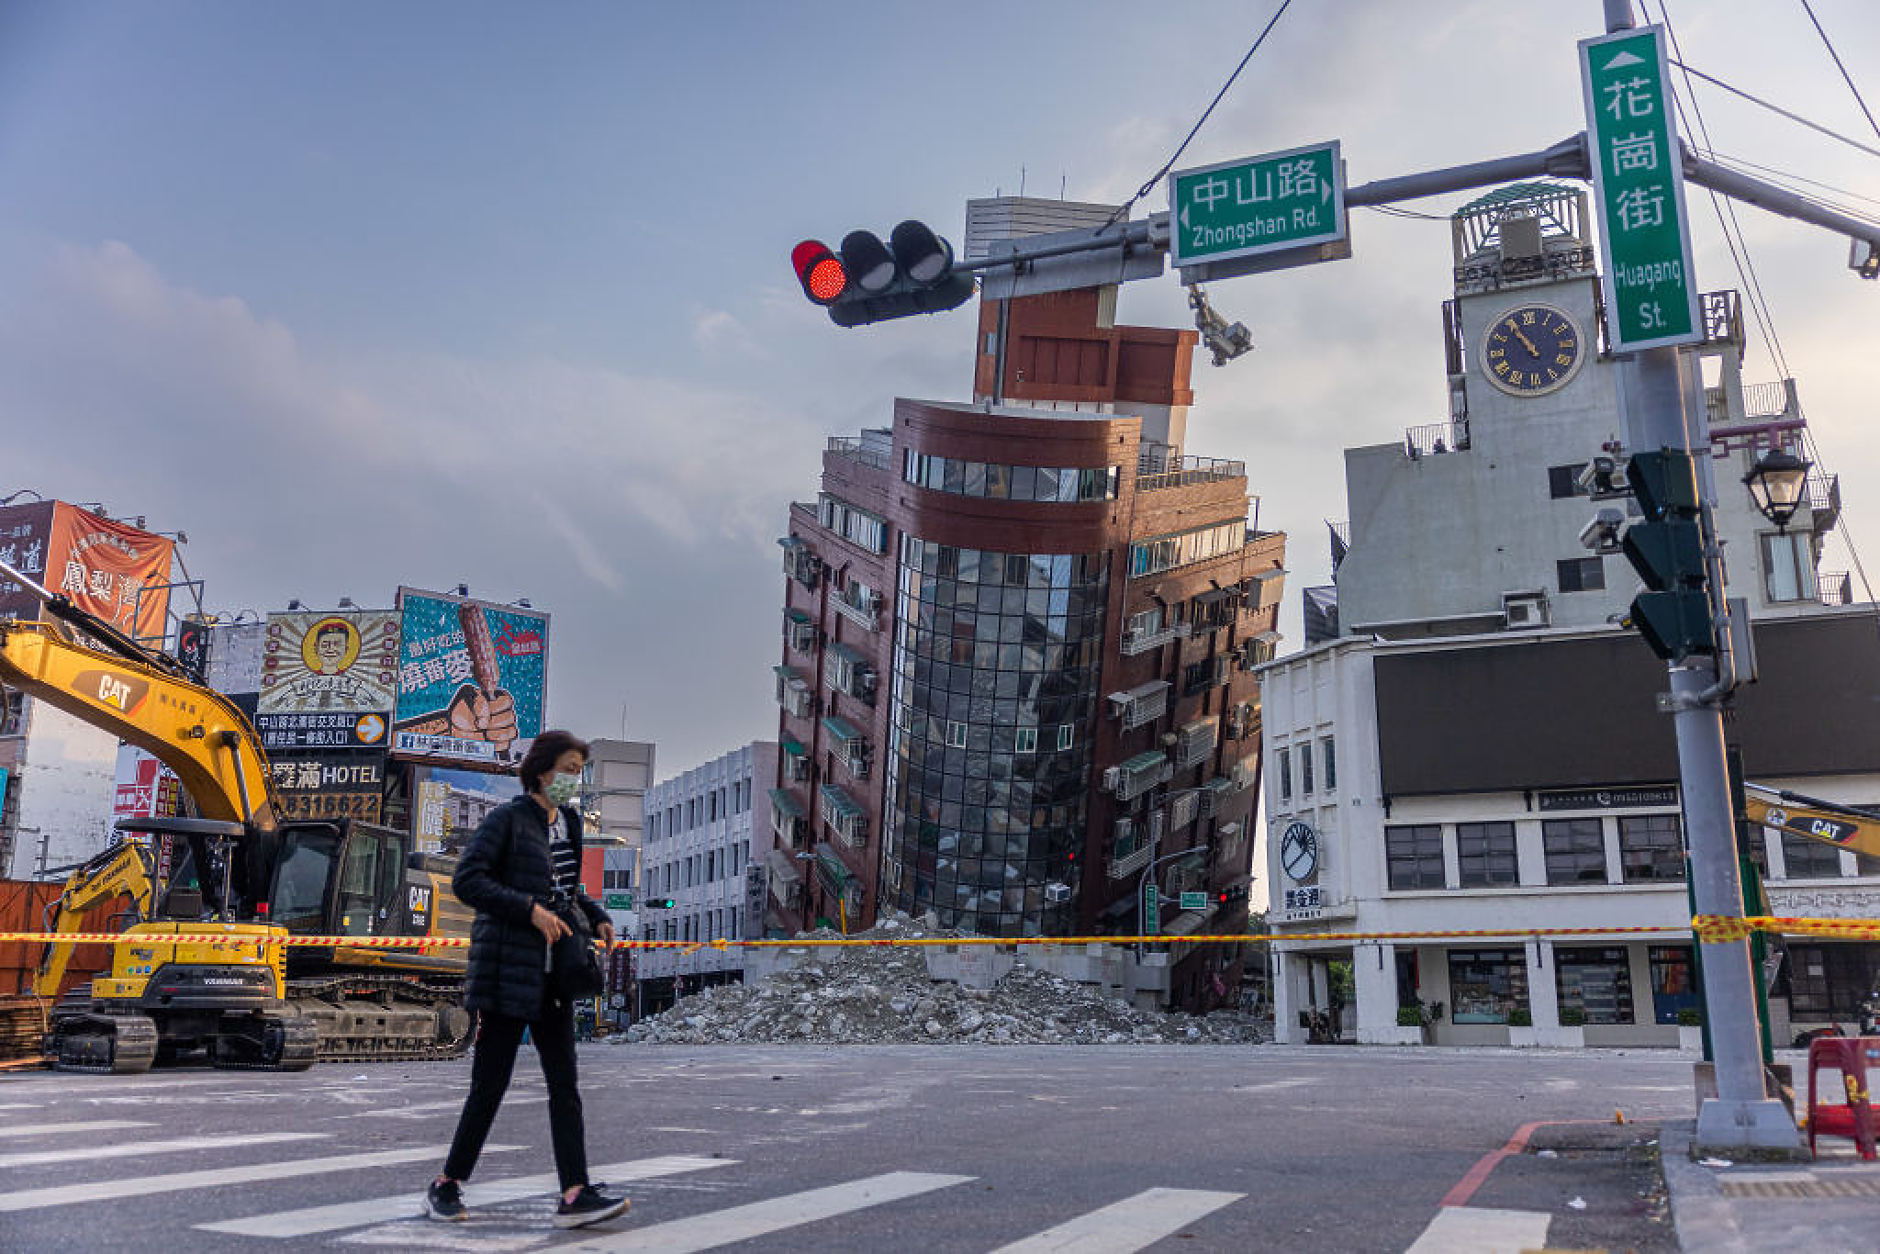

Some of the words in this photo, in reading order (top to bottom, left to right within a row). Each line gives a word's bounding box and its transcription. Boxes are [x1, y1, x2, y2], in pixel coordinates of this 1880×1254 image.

[1602, 77, 1664, 231] 花崗街
[1193, 159, 1317, 212] 中山路
[1193, 215, 1286, 247] Zhongshan
[1293, 205, 1321, 230] Rd.
[1614, 258, 1682, 290] Huagang
[1639, 302, 1667, 328] St.
[99, 674, 131, 710] CAT
[322, 764, 381, 785] HOTEL
[1811, 820, 1842, 840] CAT
[409, 886, 431, 911] CAT
